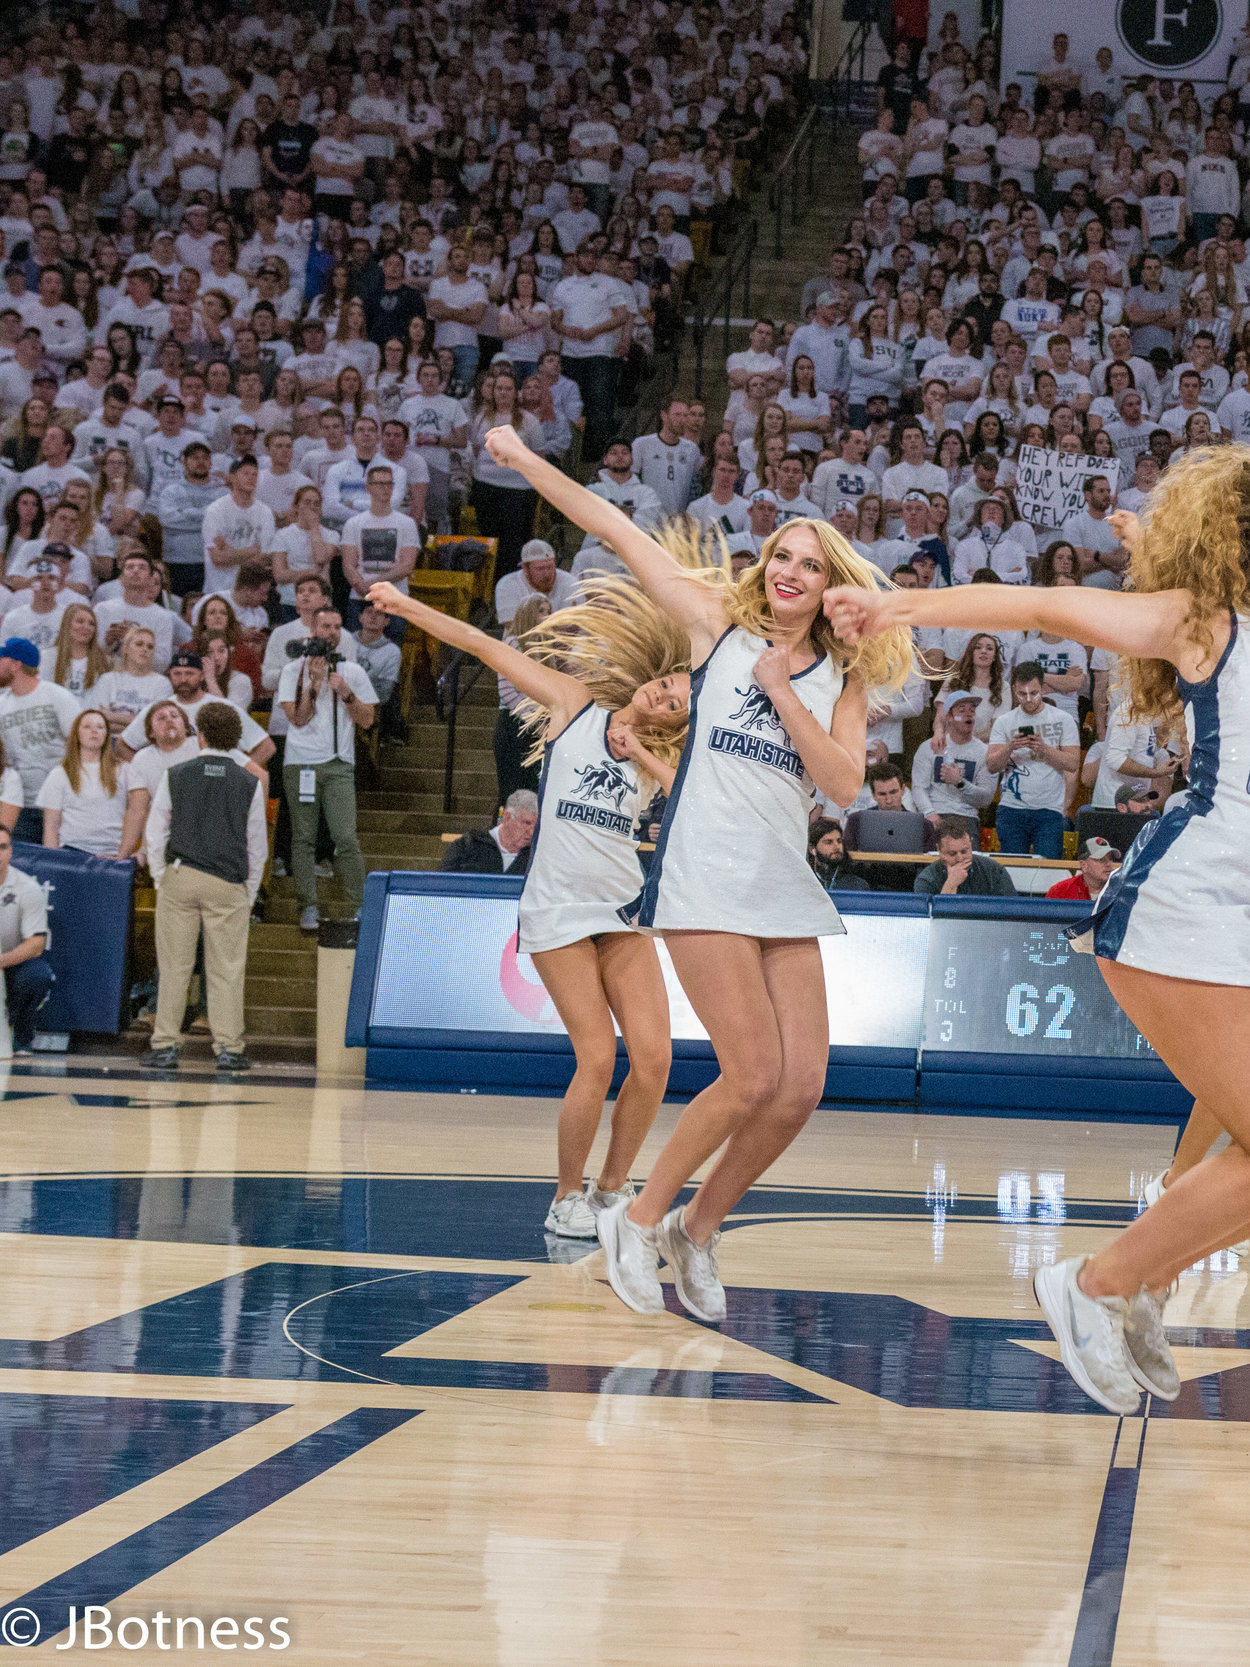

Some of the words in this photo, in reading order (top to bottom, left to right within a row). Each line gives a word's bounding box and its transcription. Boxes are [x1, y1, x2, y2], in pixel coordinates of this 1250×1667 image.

[1021, 446, 1053, 466] HEY
[1057, 452, 1086, 468] REF
[1087, 455, 1117, 470] DOES
[667, 465, 674, 480] 8
[1019, 466, 1052, 488] YOUR
[1016, 486, 1054, 502] KNOW
[708, 726, 762, 760] UTAH
[761, 738, 804, 780] STATE
[556, 799, 597, 825] UTAH
[596, 808, 633, 837] STATE
[948, 947, 957, 960] F
[944, 968, 957, 988] 8
[935, 999, 966, 1014] TOL
[1005, 982, 1076, 1039] 62
